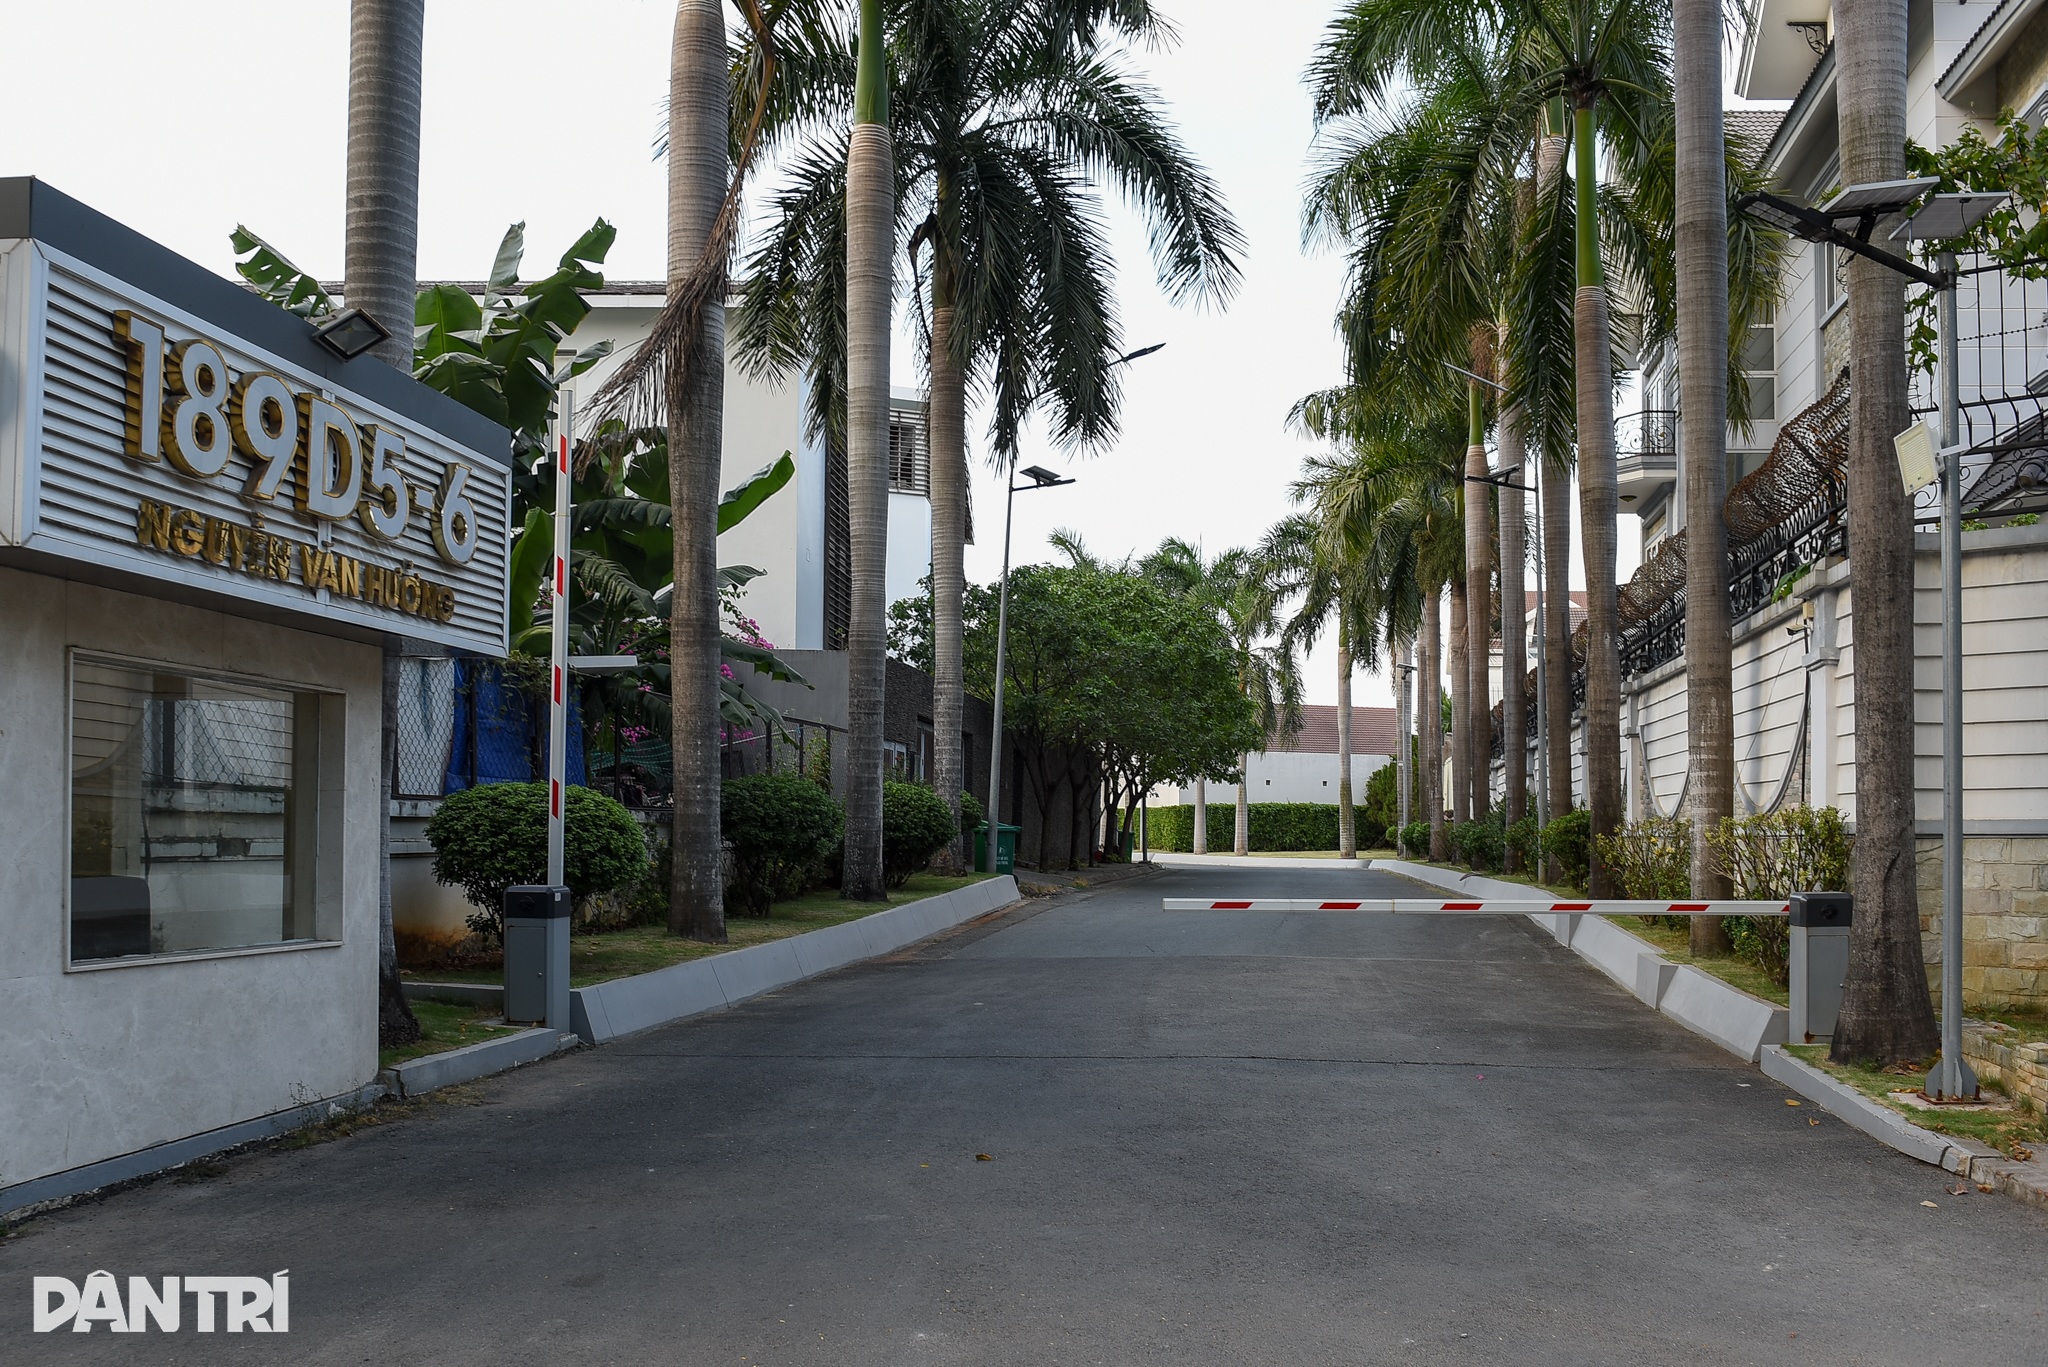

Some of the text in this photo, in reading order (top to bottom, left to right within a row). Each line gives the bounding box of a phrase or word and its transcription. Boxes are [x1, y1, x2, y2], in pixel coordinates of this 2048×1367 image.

[113, 310, 478, 566] 189D5-6
[138, 499, 292, 581] NGUYỄN
[301, 540, 359, 598] VĂN
